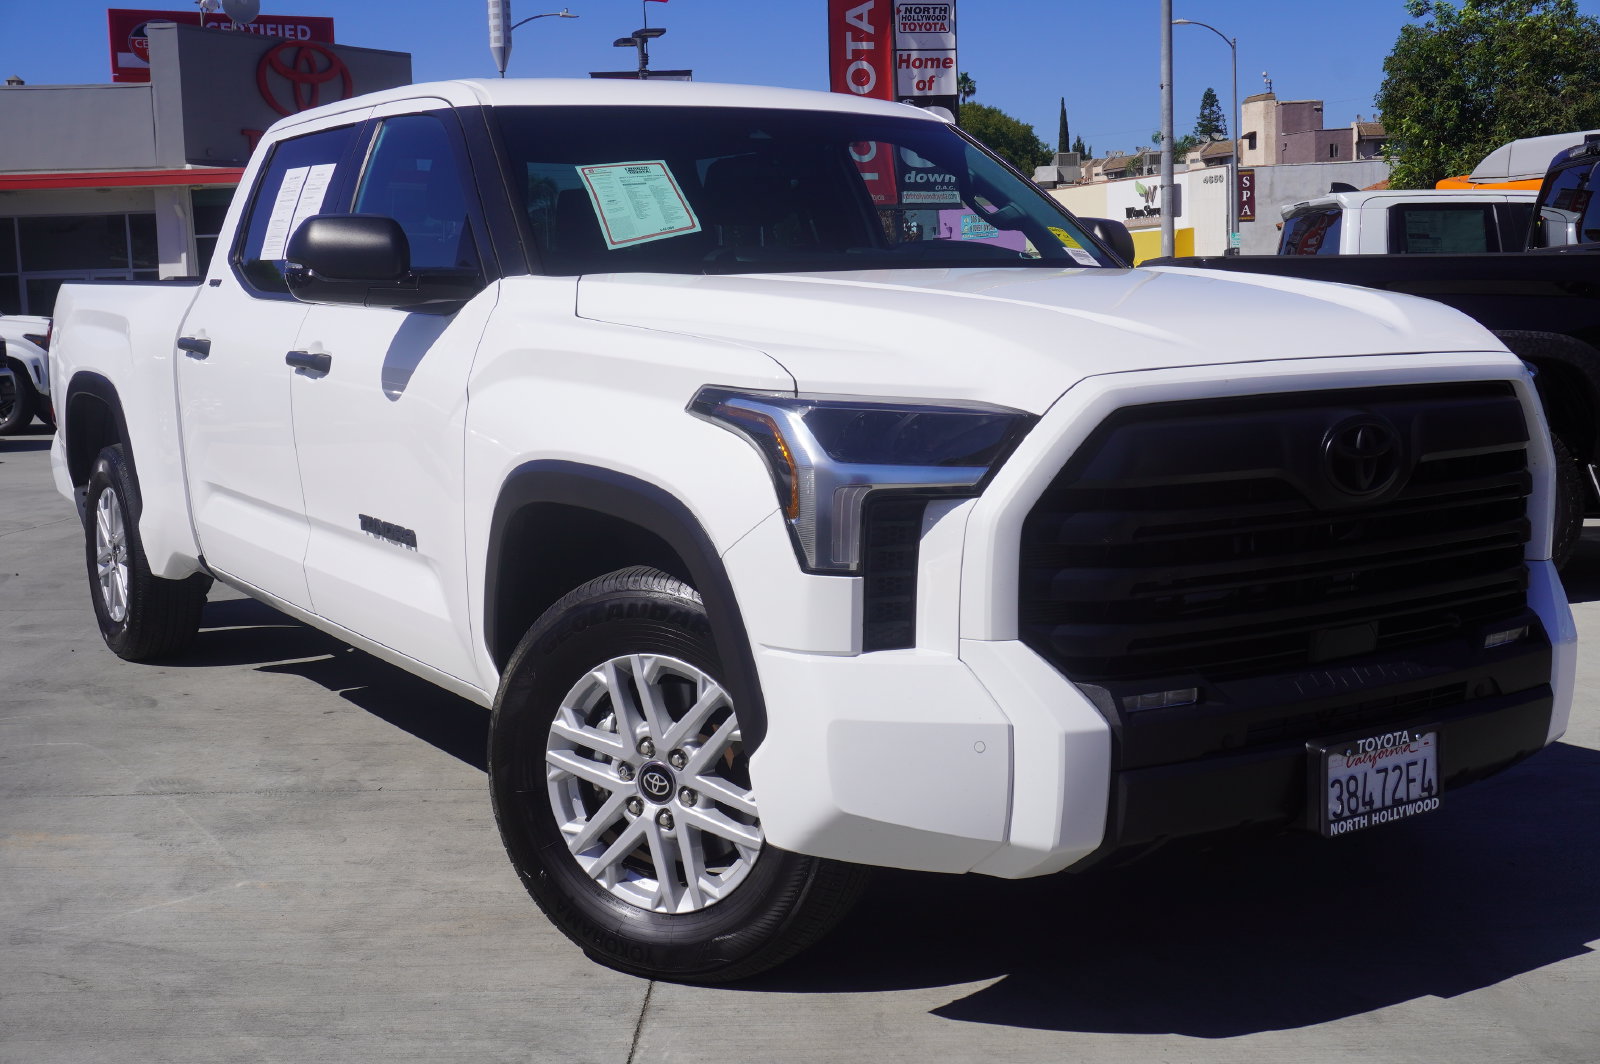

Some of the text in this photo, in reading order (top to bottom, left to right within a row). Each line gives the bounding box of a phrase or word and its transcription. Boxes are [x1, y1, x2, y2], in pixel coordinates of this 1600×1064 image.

[904, 6, 948, 15] NORTH
[901, 22, 947, 32] TOYOTA
[897, 54, 954, 70] Home
[915, 75, 936, 91] of
[904, 171, 956, 183] down
[1357, 730, 1410, 754] TOYOTA
[1345, 743, 1418, 769] California
[1330, 758, 1434, 818] 38472F4
[1330, 798, 1440, 836] NORTH HOLLYWOOD
